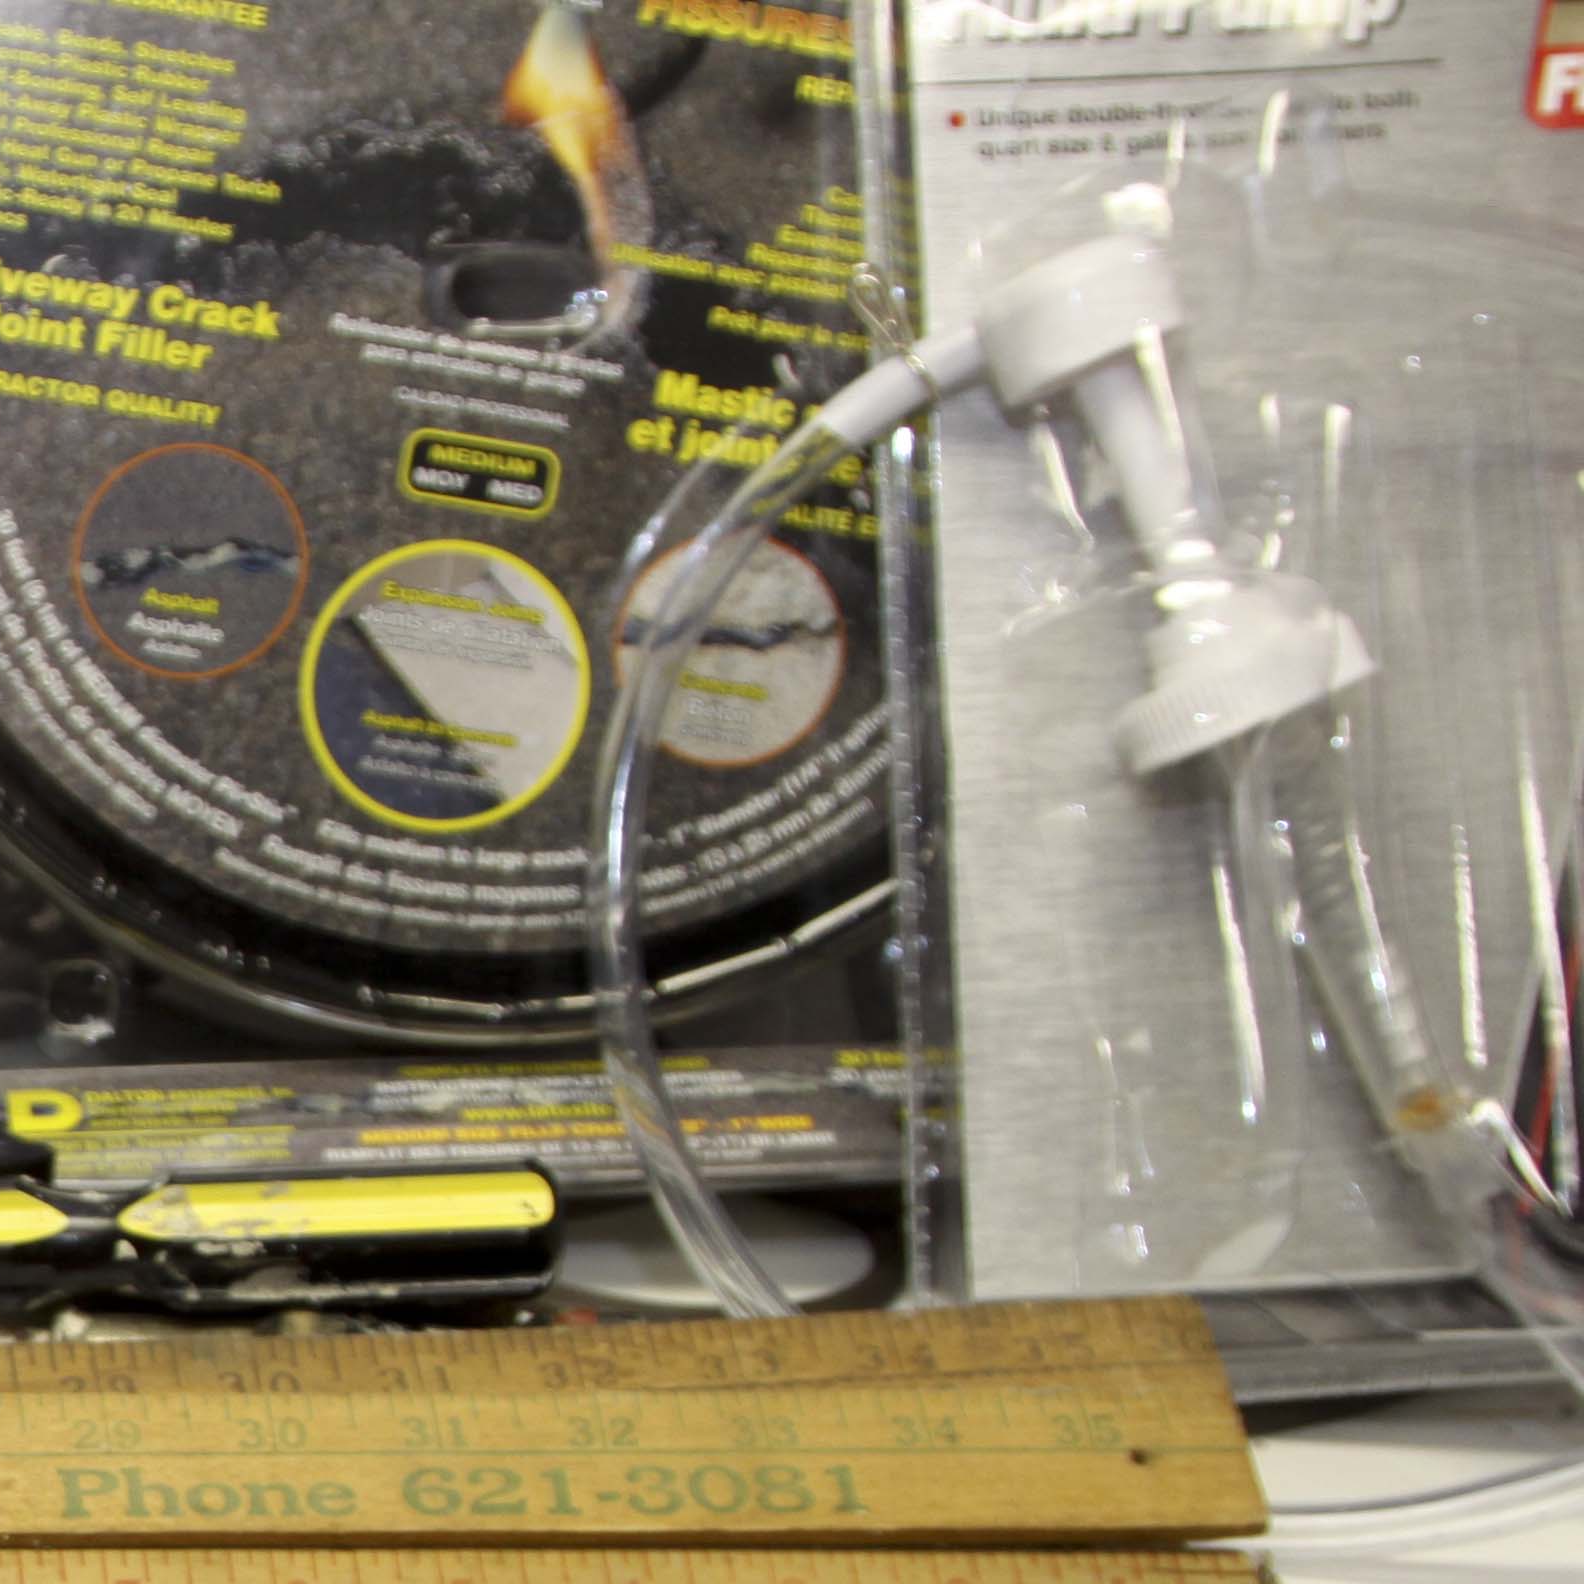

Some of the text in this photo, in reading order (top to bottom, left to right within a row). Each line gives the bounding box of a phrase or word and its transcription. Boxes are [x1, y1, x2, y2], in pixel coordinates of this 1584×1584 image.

[148, 285, 281, 340] Crack
[95, 320, 214, 371] Filler
[105, 389, 221, 427] QUALITY
[654, 370, 796, 428] Mastic
[627, 416, 675, 454] et
[428, 444, 536, 478] MEDIUM
[486, 479, 543, 506] MED
[141, 587, 220, 614] Asphalt
[73, 1419, 141, 1448] 29
[238, 1418, 307, 1448] 30
[403, 1417, 467, 1447] 31
[569, 1417, 637, 1447] 32
[733, 1416, 798, 1446] 33
[893, 1416, 958, 1444] 34
[1054, 1413, 1122, 1446] 35
[55, 1467, 357, 1518] Phone
[402, 1464, 869, 1517] 621-3081
